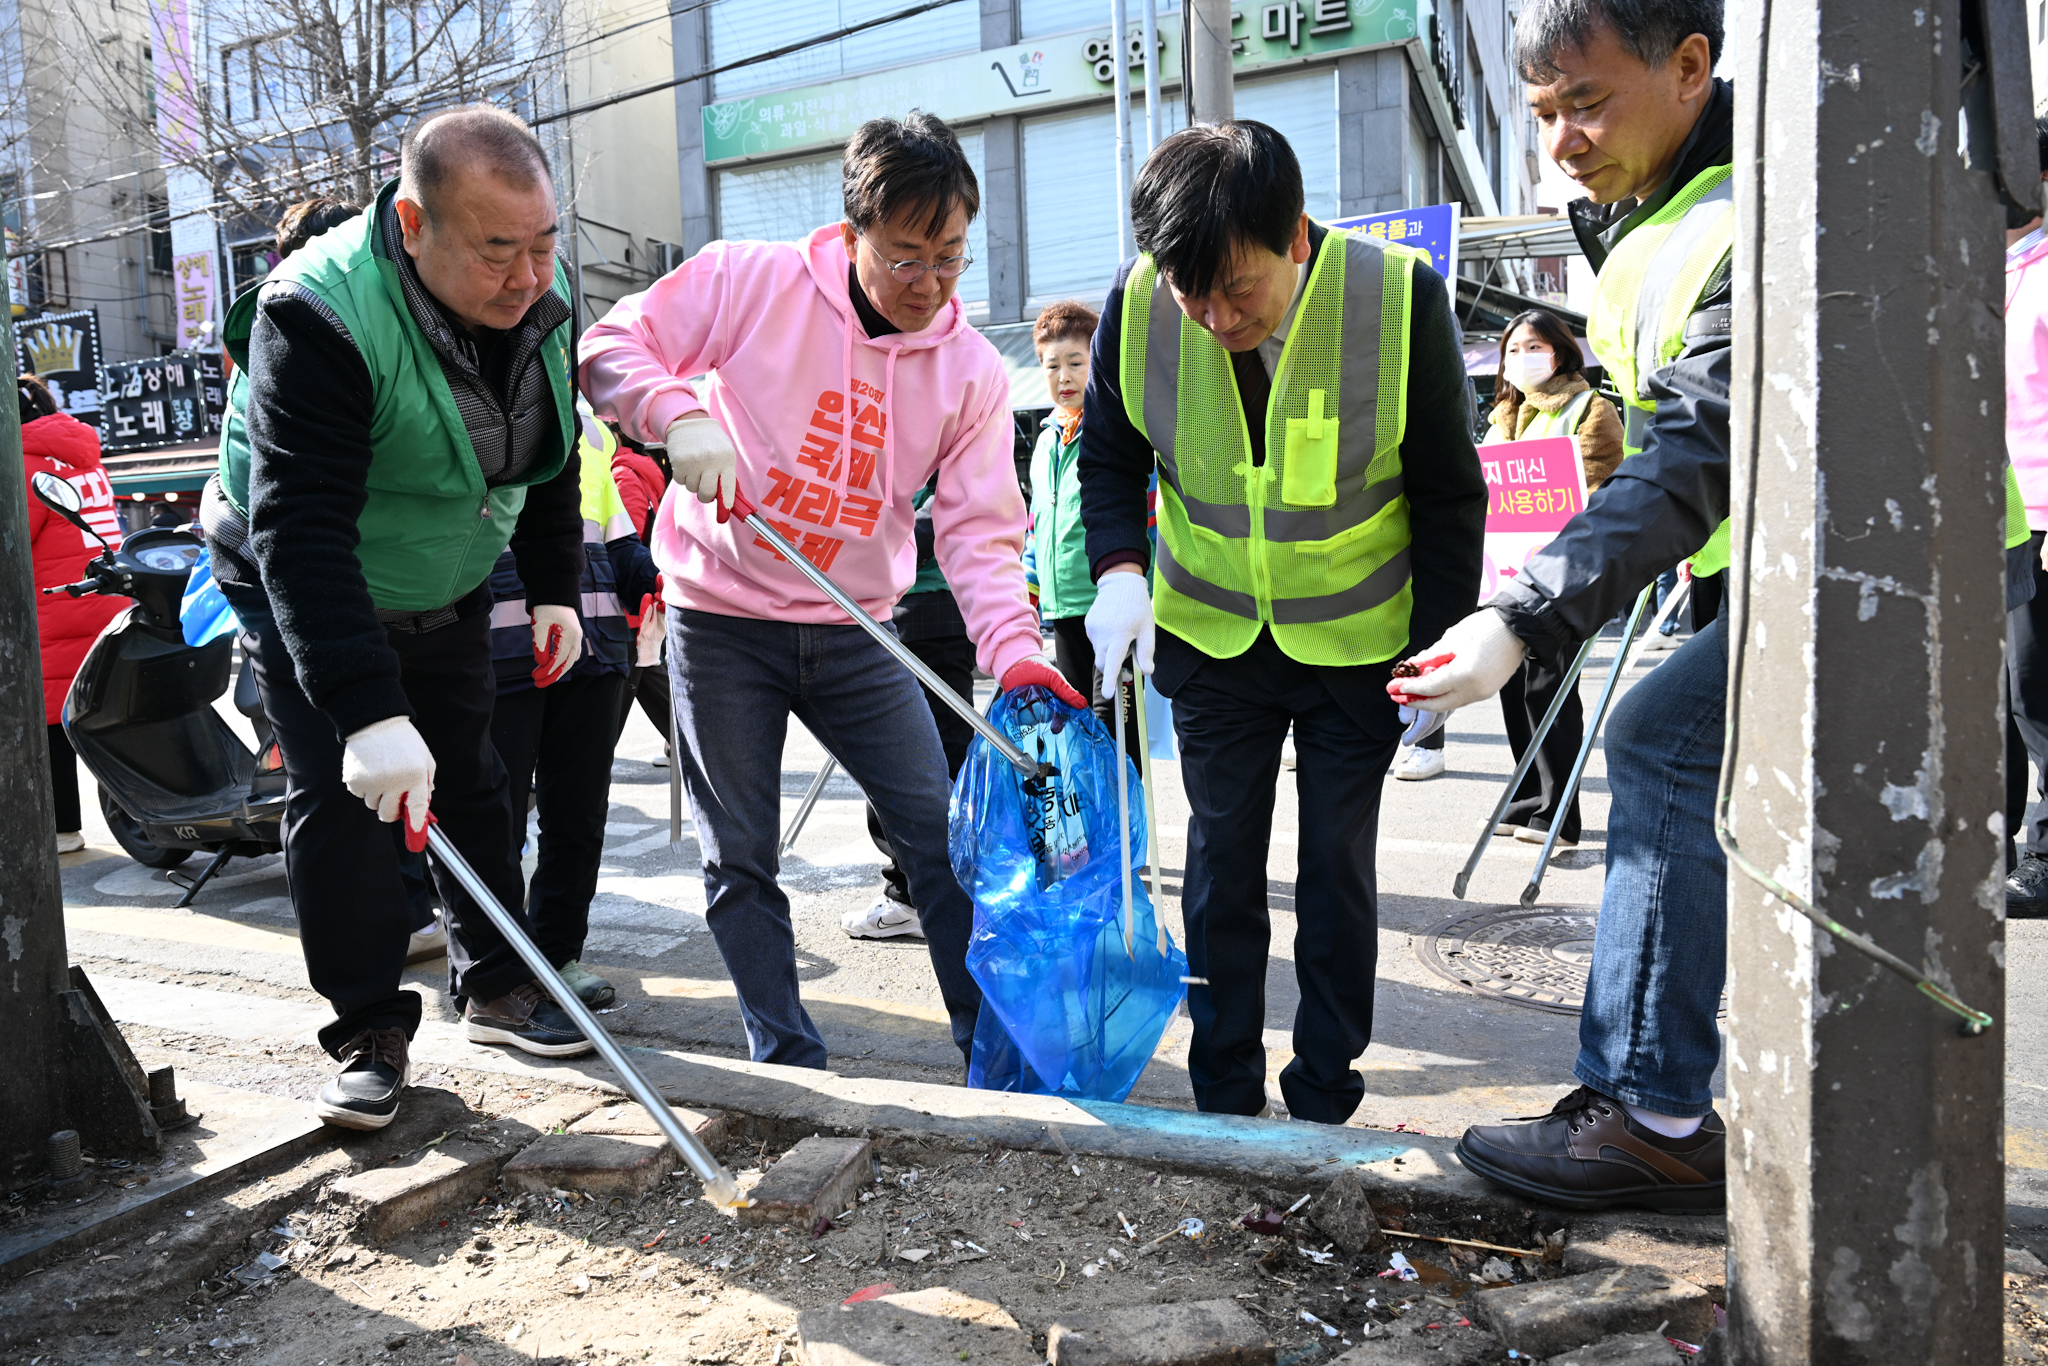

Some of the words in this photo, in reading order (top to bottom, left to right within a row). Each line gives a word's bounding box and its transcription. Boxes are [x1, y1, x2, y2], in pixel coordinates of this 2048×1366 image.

[144, 363, 185, 391] 상해
[796, 432, 876, 490] 국제
[1507, 457, 1547, 484] 대신
[761, 466, 883, 537] 거리극
[1498, 487, 1576, 515] 사용하기
[752, 517, 845, 573] 축제
[174, 826, 200, 840] KR
